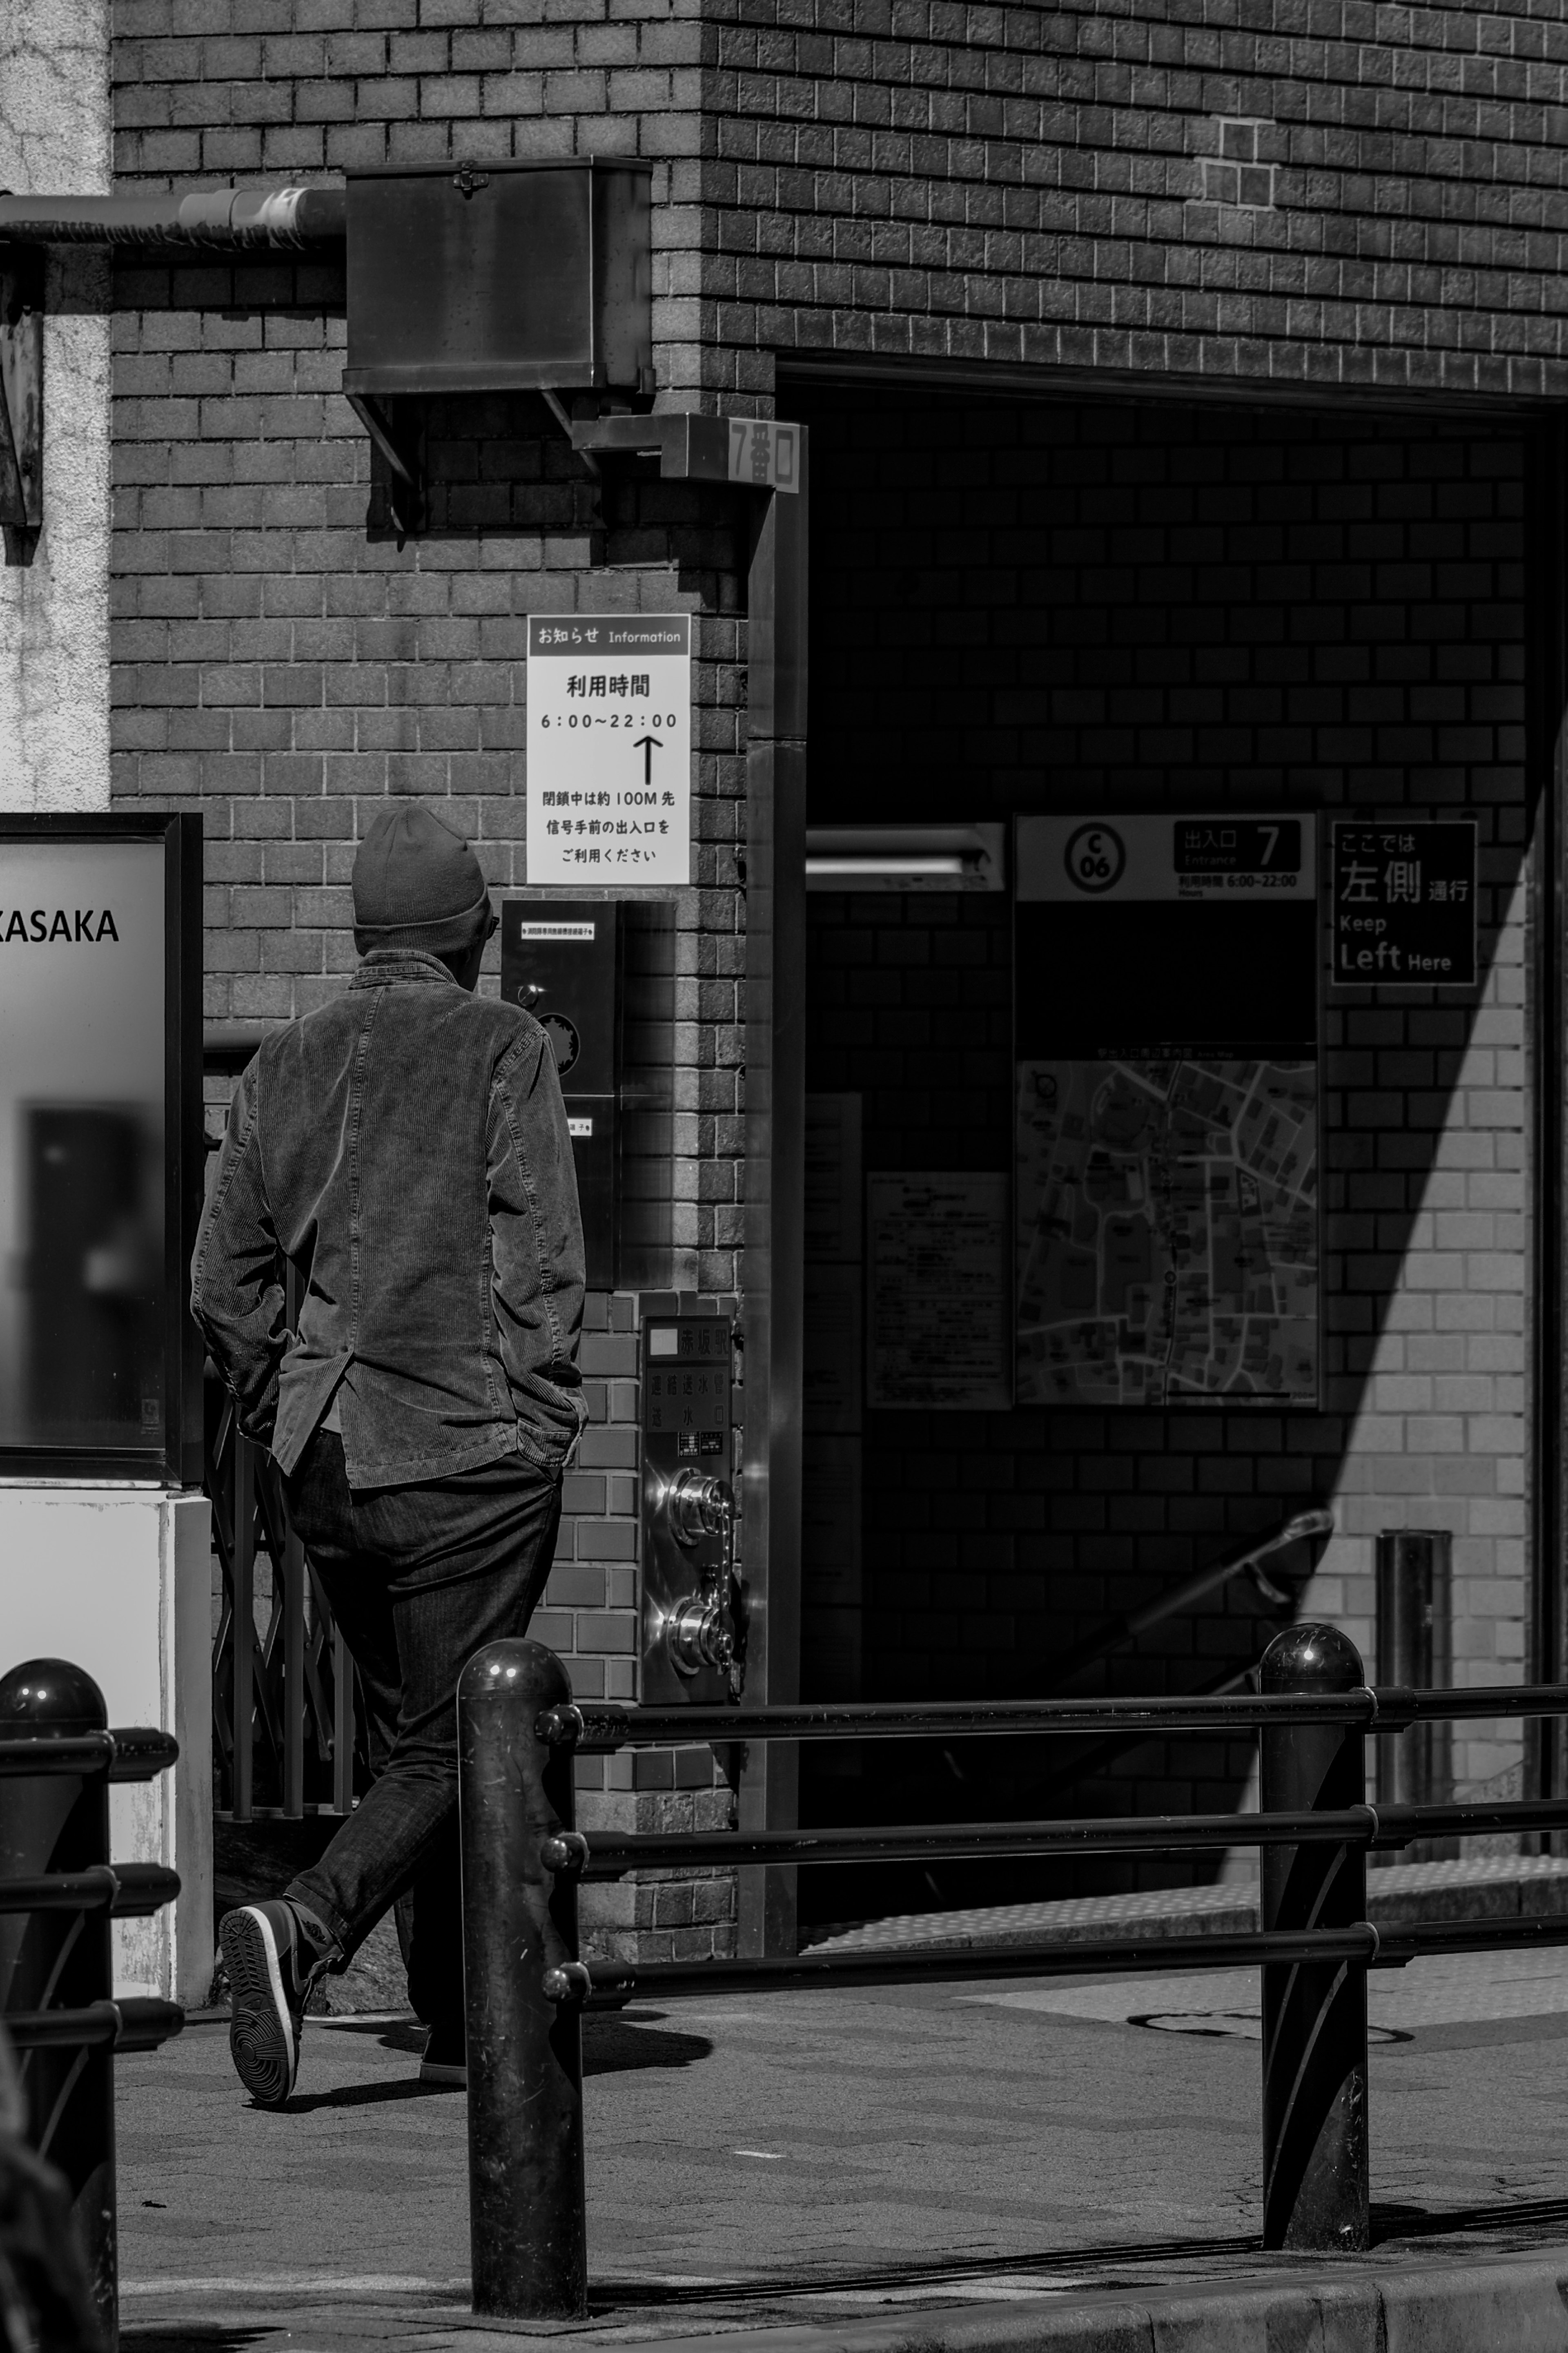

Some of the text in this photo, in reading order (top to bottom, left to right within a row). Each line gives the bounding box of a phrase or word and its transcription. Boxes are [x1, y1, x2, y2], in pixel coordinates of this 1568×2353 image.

[539, 627, 681, 645] お知らせ Information
[566, 674, 650, 698] 利用時間
[546, 819, 669, 835] 信号手前の出入口を
[1088, 834, 1101, 854] C
[1185, 830, 1237, 849] 出入口
[1256, 826, 1280, 865] 7
[1341, 833, 1416, 853] ここでは
[562, 848, 656, 863] ご利用ください
[1185, 854, 1237, 866] Entrance
[1080, 856, 1109, 877] 06
[1179, 875, 1223, 888] 利用時間
[0, 910, 119, 942] ASAKA
[1340, 914, 1387, 936] Keep
[1341, 941, 1452, 971] Left Here
